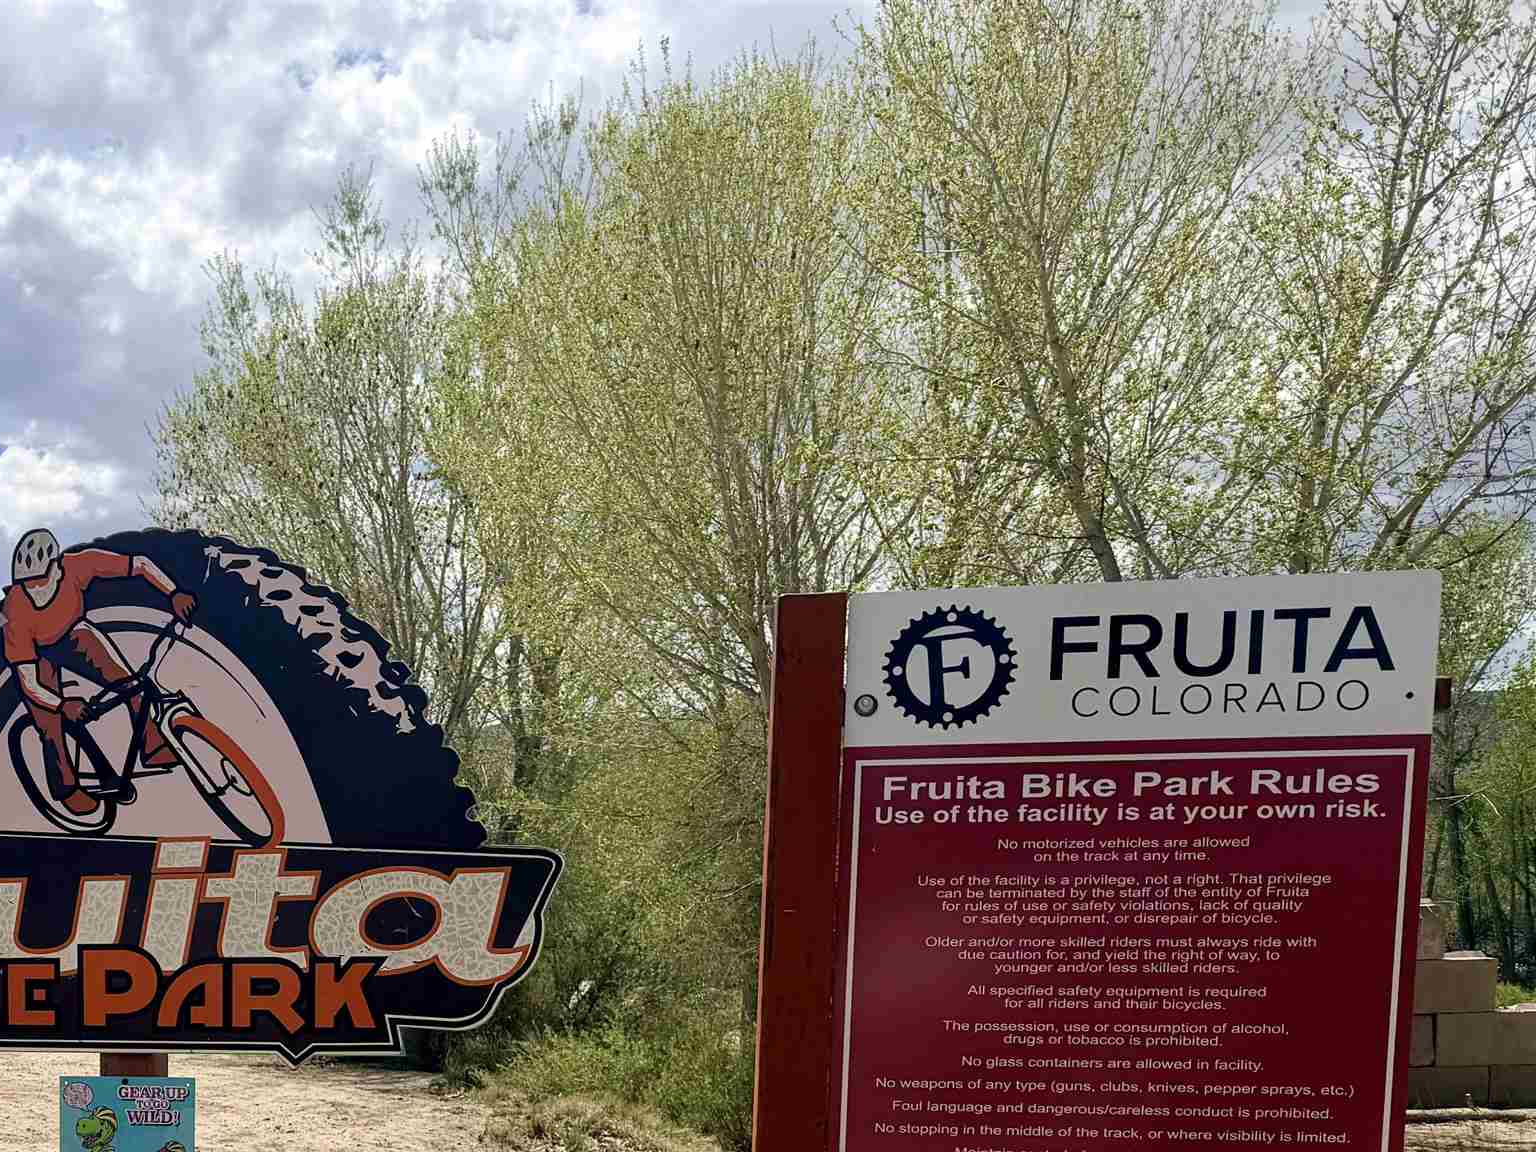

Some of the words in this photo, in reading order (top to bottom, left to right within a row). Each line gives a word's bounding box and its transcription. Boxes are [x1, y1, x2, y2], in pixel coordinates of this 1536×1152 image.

[1049, 606, 1396, 681] FRUITA
[1071, 679, 1370, 718] COLORADO
[882, 775, 1006, 801] Fruita
[1021, 772, 1117, 799] Bike
[1132, 769, 1235, 797] Park
[1249, 767, 1380, 795] Rules
[874, 805, 925, 825] Use
[932, 804, 961, 824] of
[966, 804, 1009, 824] the
[1016, 802, 1109, 826] facility
[1116, 802, 1141, 821] is
[1148, 802, 1176, 821] at
[1182, 804, 1249, 825] your
[1255, 803, 1316, 820] own
[1325, 798, 1387, 818] risk.
[924, 935, 965, 948] Older
[967, 935, 1015, 947] and/or
[1018, 937, 1056, 948] more
[1059, 935, 1106, 948] skilled
[1109, 935, 1152, 948] riders
[1155, 936, 1193, 948] must
[1196, 935, 1249, 949] always
[1252, 935, 1283, 948] ride
[1285, 935, 1317, 948] with
[957, 949, 985, 961] due
[989, 949, 1042, 961] caution
[1045, 948, 1068, 961] for,
[1072, 949, 1101, 961] and
[1104, 948, 1139, 963] yield
[1143, 949, 1167, 961] the
[1170, 948, 1205, 963] right
[1207, 948, 1225, 961] of
[1226, 947, 1261, 963] way,
[1265, 949, 1281, 961] to
[994, 963, 1054, 975] younger
[1056, 961, 1105, 974] and/or
[1108, 961, 1138, 973] less
[1141, 961, 1189, 974] skilled
[1192, 962, 1240, 974] riders.
[82, 949, 376, 1034] PARK
[966, 984, 986, 996] All
[989, 984, 1054, 998] specified
[1057, 984, 1103, 999] safety
[1105, 985, 1184, 999] equipment
[1187, 985, 1201, 997] is
[1204, 985, 1267, 1000] required
[1004, 996, 1024, 1009] for
[1026, 997, 1045, 1009] all
[1047, 997, 1090, 1009] riders
[1093, 996, 1121, 1009] and
[1125, 997, 1159, 1010] their
[1162, 998, 1227, 1012] bicycles.
[960, 1055, 982, 1067] No
[985, 1055, 1024, 1070] glass
[1027, 1057, 1103, 1069] containers
[1106, 1059, 1132, 1069] are
[1135, 1057, 1193, 1070] allowed
[1196, 1058, 1210, 1071] in
[1213, 1058, 1264, 1073] facility.
[118, 1086, 162, 1099] GEAR
[164, 1086, 188, 1100] UP
[875, 1076, 896, 1089] No
[898, 1079, 964, 1092] weapons
[967, 1078, 983, 1090] of
[984, 1080, 1012, 1093] any
[1015, 1079, 1047, 1093] type
[1050, 1079, 1096, 1094] (guns,
[1099, 1079, 1143, 1094] clubs,
[1147, 1081, 1199, 1095] knives,
[1203, 1084, 1258, 1097] pepper
[1259, 1085, 1316, 1098] sprays,
[1320, 1084, 1355, 1099] etc.)
[136, 1099, 152, 1109] TO
[152, 1099, 169, 1109] GO
[892, 1099, 923, 1112] Foul
[926, 1100, 993, 1115] language
[996, 1102, 1024, 1113] and
[1026, 1102, 1171, 1117] dangerous/careless
[1174, 1105, 1234, 1118] conduct
[1237, 1106, 1251, 1119] is
[1254, 1106, 1334, 1121] prohibited.
[127, 1110, 180, 1125] WILD!
[874, 1122, 896, 1134] No
[897, 1122, 959, 1137] stopping
[962, 1125, 975, 1136] in
[979, 1124, 1002, 1136] the
[1005, 1124, 1055, 1137] middle
[1057, 1125, 1073, 1137] of
[1075, 1127, 1099, 1138] the
[1103, 1127, 1143, 1141] track,
[1147, 1130, 1164, 1140] or
[1166, 1128, 1213, 1141] where
[1216, 1129, 1276, 1145] visibility
[1279, 1130, 1293, 1143] is
[1296, 1130, 1351, 1144] limited.
